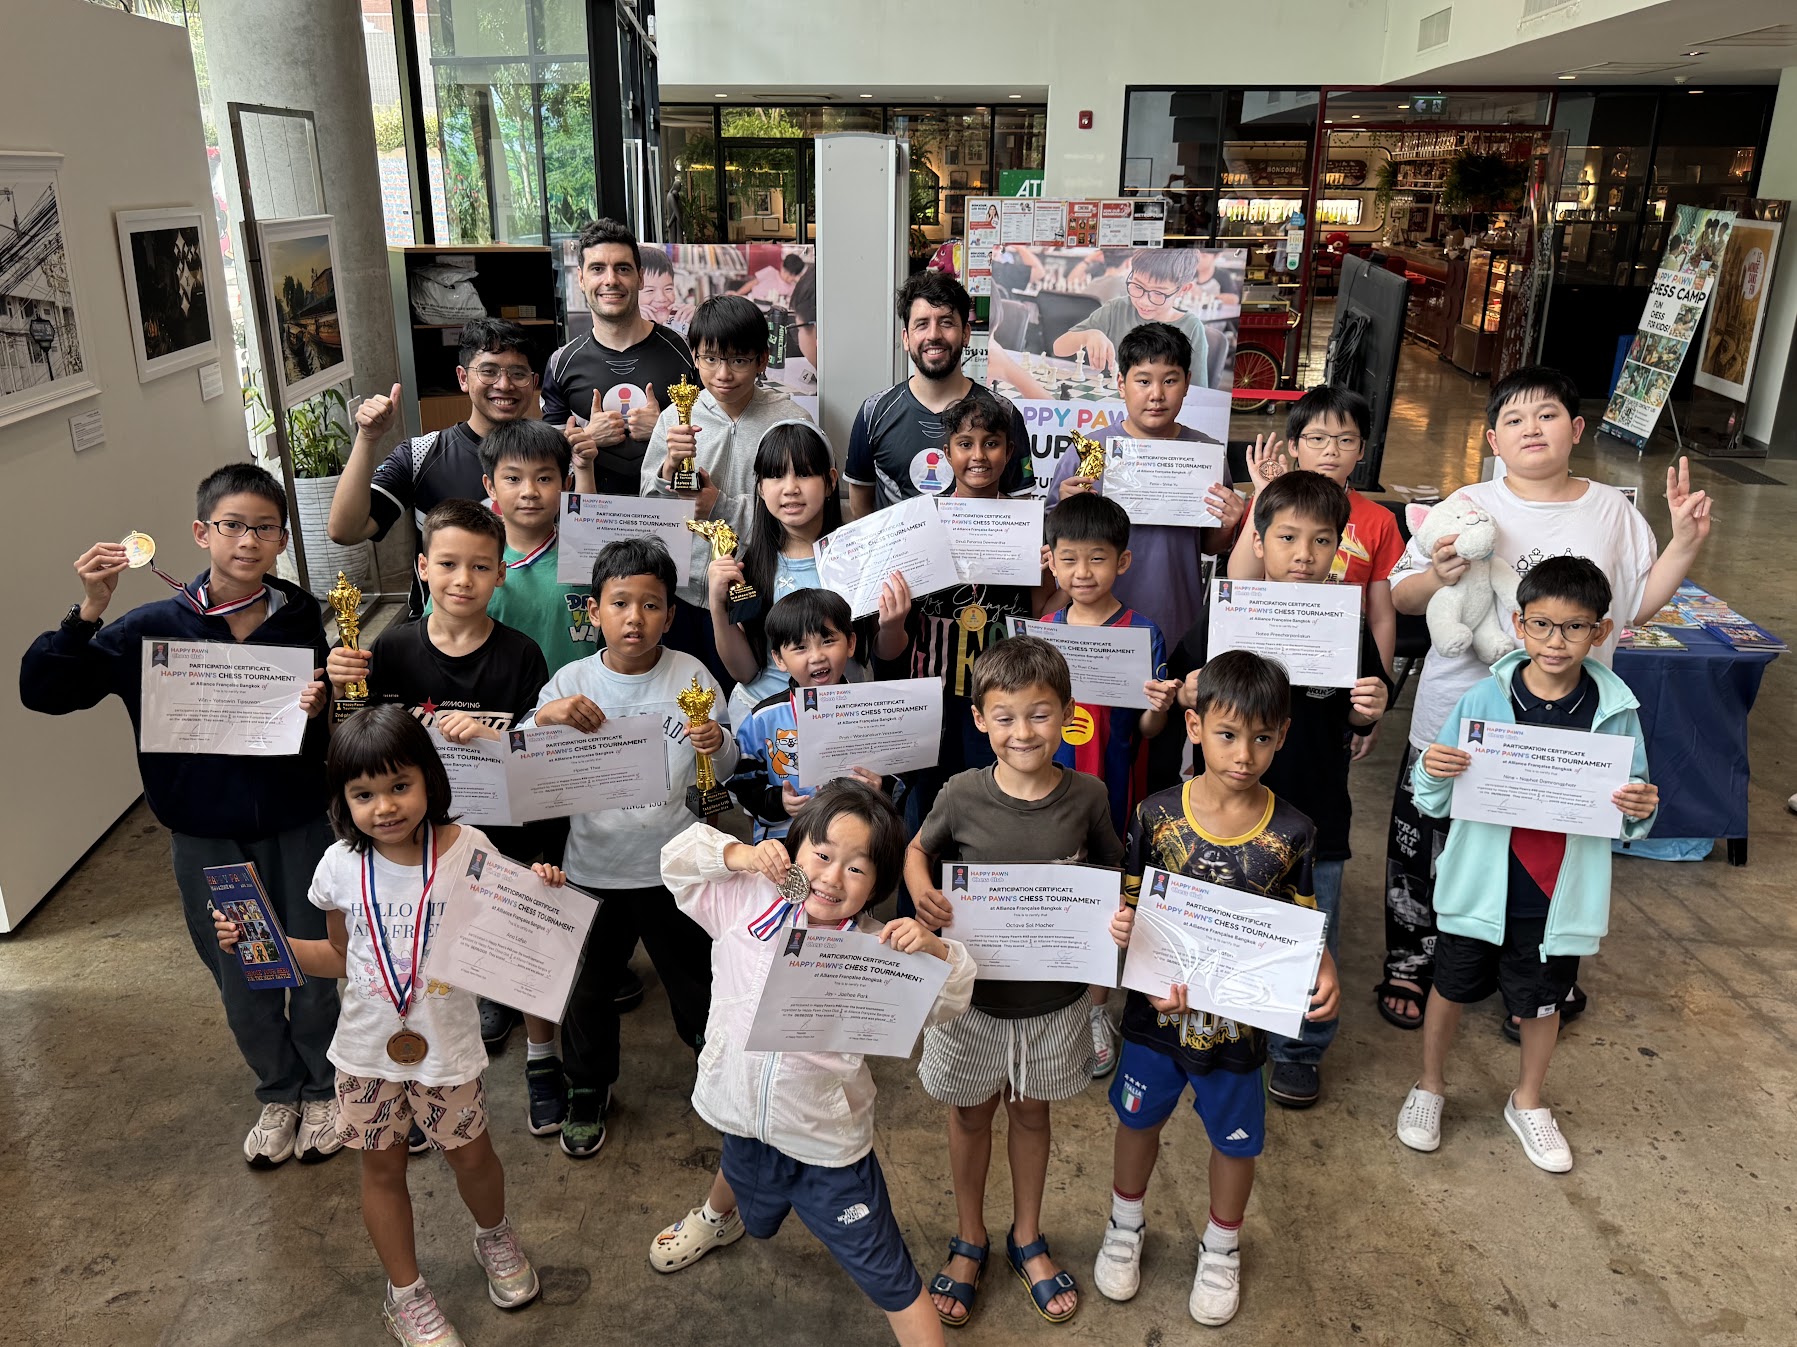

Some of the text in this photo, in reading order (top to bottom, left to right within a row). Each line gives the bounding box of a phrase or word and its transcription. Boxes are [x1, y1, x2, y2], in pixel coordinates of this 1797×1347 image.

[1677, 288, 1706, 304] CAMP
[1024, 406, 1126, 429] PPY PAW
[886, 520, 927, 540] TOURNAMENT
[1296, 610, 1344, 618] TOURNAMENT
[218, 672, 242, 680] CHESS
[244, 674, 296, 682] TOURNAMENT
[883, 705, 928, 714] TOURNAMENT
[520, 738, 648, 760] HAPPY PAWN'S CHESS TOURNAMENT
[546, 735, 623, 748] PARTICIPATION CERTIFICATE
[446, 746, 481, 754] CERTIFICATE
[1503, 743, 1586, 757] PARTICIPATION CERTIFICATE
[1475, 747, 1612, 769] HAPPY PAWN'S CHESS TOURNAMENT
[487, 860, 504, 872] HAPPY
[1171, 880, 1209, 895] HAPPY PAWN
[497, 884, 560, 915] PARTICIPATION CERTIFICATE
[1045, 896, 1102, 906] TOURNAMENT
[351, 903, 412, 917] HLLO
[470, 884, 575, 932] HAPPY PAWN'S CHESS TOURNAMENT
[1186, 901, 1272, 929] PARTICIPATION CERTIFICATE
[1156, 902, 1299, 947] HAPPY PAWN'S CHESS TOURNAMENT
[1235, 935, 1256, 945] Bangkok
[819, 953, 901, 968] PARTICIPATION CERTIFICATE
[789, 960, 924, 983] HAPPY PAWN'S CHESS TOURNAMENT
[862, 976, 883, 984] Bangkok
[1124, 1081, 1142, 1098] ITALIA
